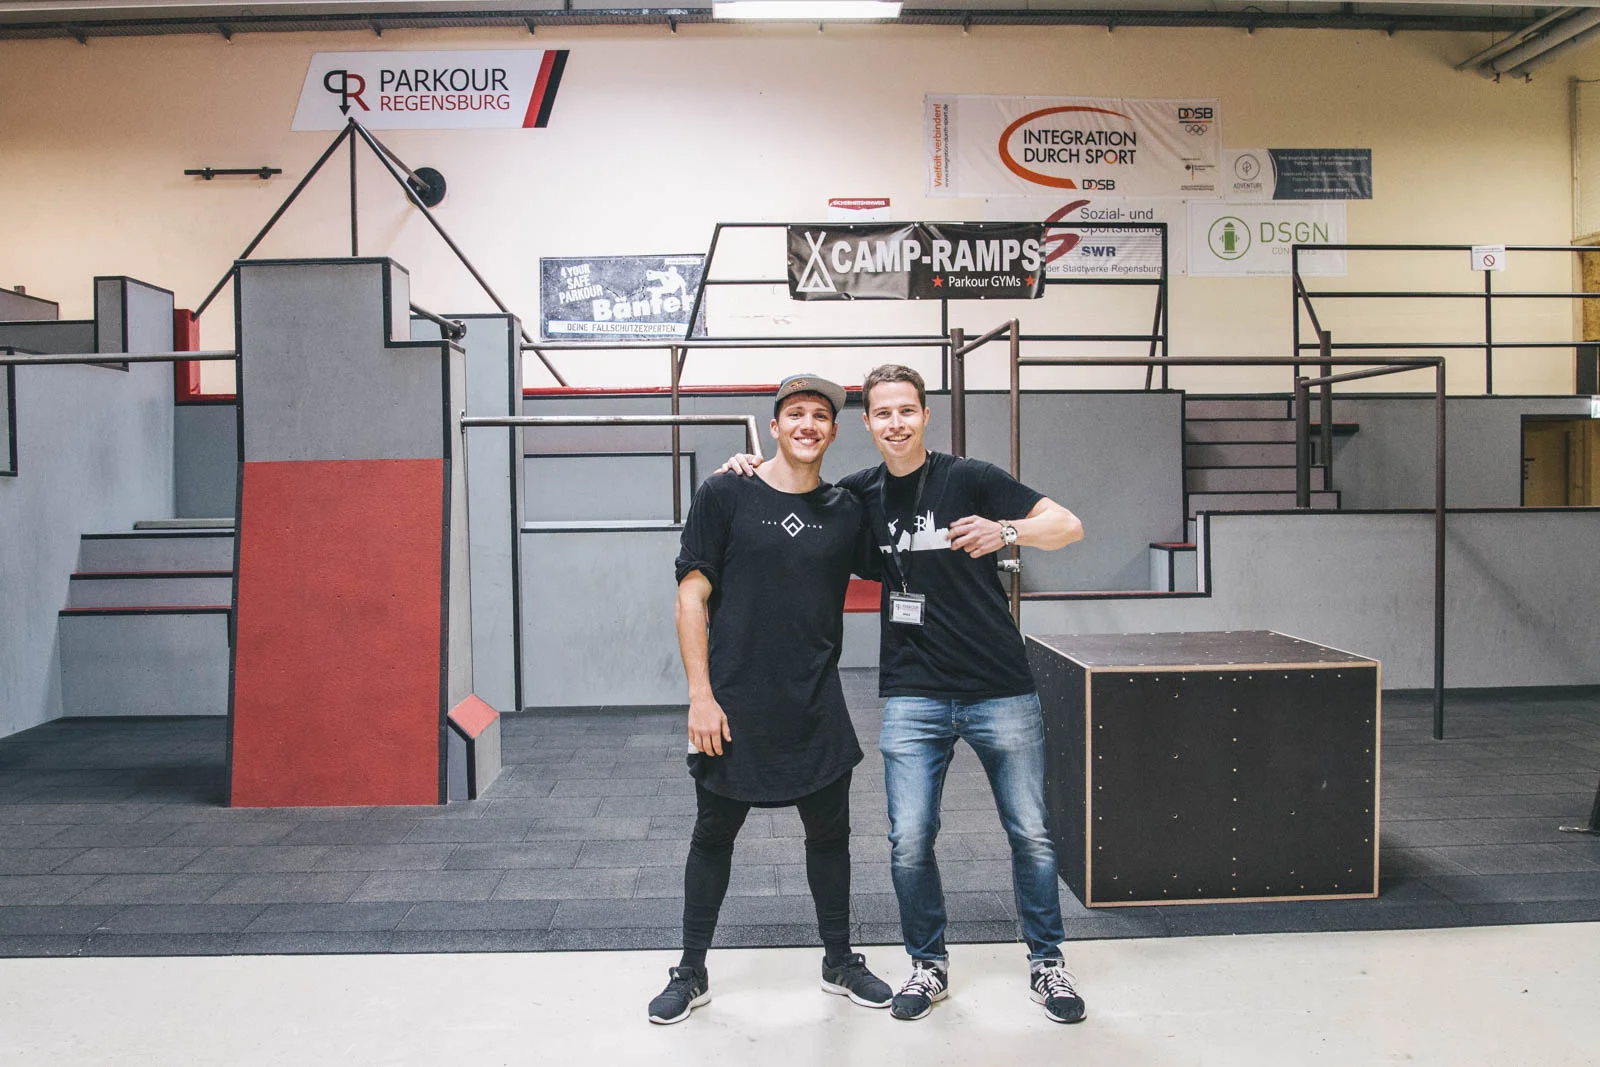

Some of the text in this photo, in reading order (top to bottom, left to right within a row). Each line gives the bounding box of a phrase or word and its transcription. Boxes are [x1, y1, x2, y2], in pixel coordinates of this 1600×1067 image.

[380, 68, 509, 92] PARKOUR
[380, 94, 510, 111] REGENSBURG
[1178, 107, 1213, 119] DOSB
[933, 103, 943, 188] Vielfalt verbinden!
[1024, 129, 1137, 147] INTEGRATION
[1024, 148, 1137, 165] DURCH SPORT
[1082, 179, 1115, 190] DOSB
[1080, 207, 1153, 220] Sozial- und
[1260, 222, 1329, 243] DSGN
[831, 239, 1041, 274] CAMP-RAMPS
[1081, 246, 1116, 257] SWR
[560, 263, 591, 279] 4 YOUR
[1046, 265, 1163, 275] der Stadtwerke Regensburg
[567, 274, 590, 290] SAFE
[948, 275, 1021, 288] Parkour GYMs
[559, 284, 604, 304] PARKOUR
[567, 323, 676, 333] DEINE FALLSCHUTZEXPERTEN
